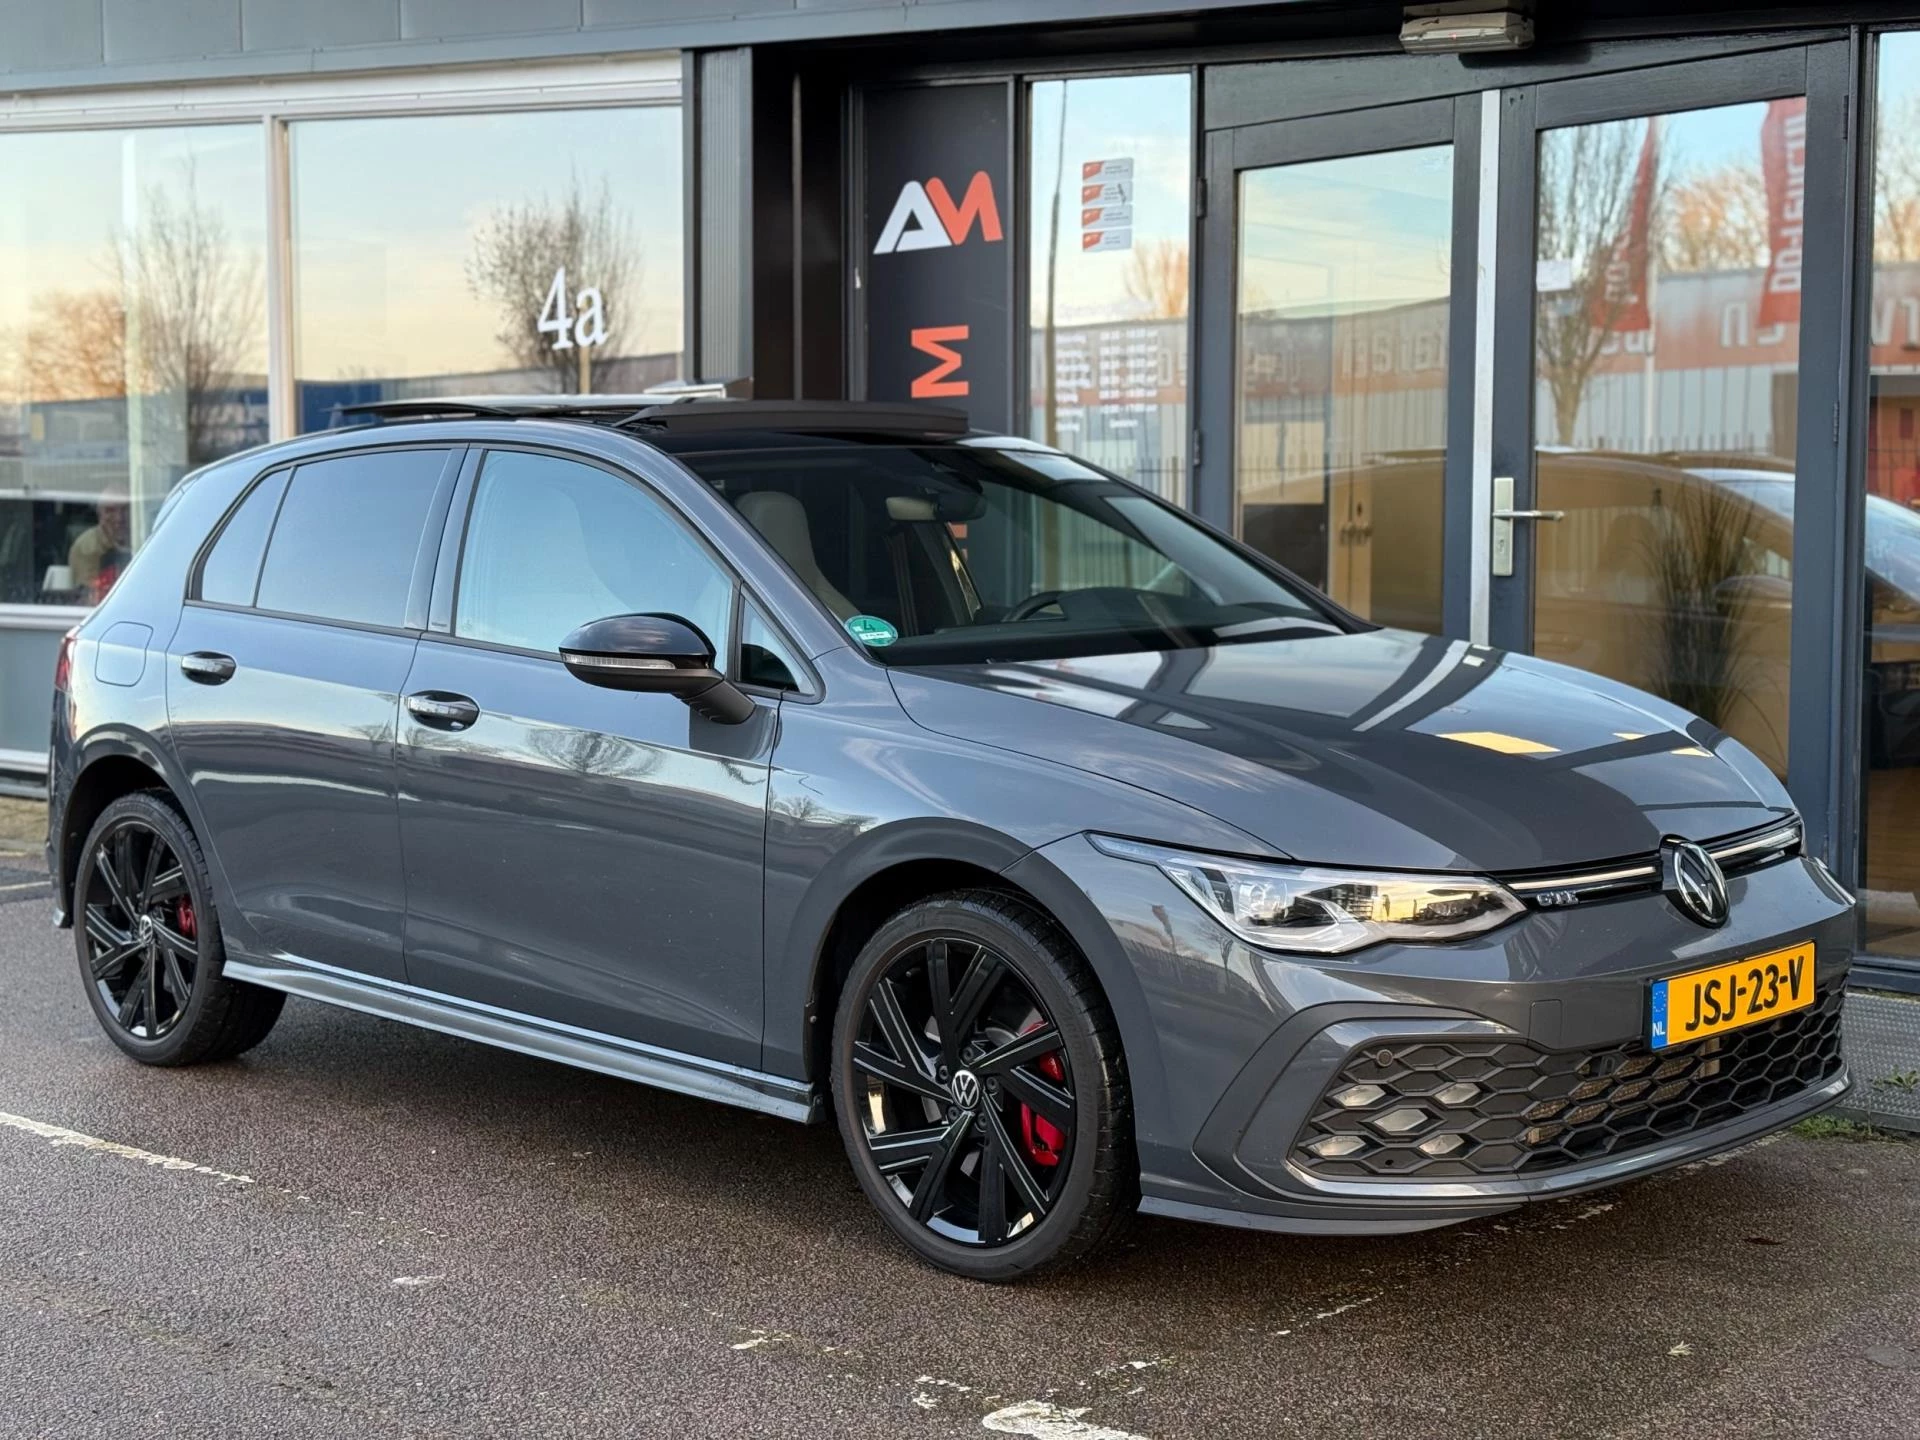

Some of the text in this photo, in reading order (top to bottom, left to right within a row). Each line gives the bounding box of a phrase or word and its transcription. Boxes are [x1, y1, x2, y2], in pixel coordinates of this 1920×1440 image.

[873, 171, 1003, 254] AM
[537, 266, 609, 350] 4a
[1652, 1021, 1666, 1037] NL
[1685, 955, 1804, 1032] JSJ-23-V
